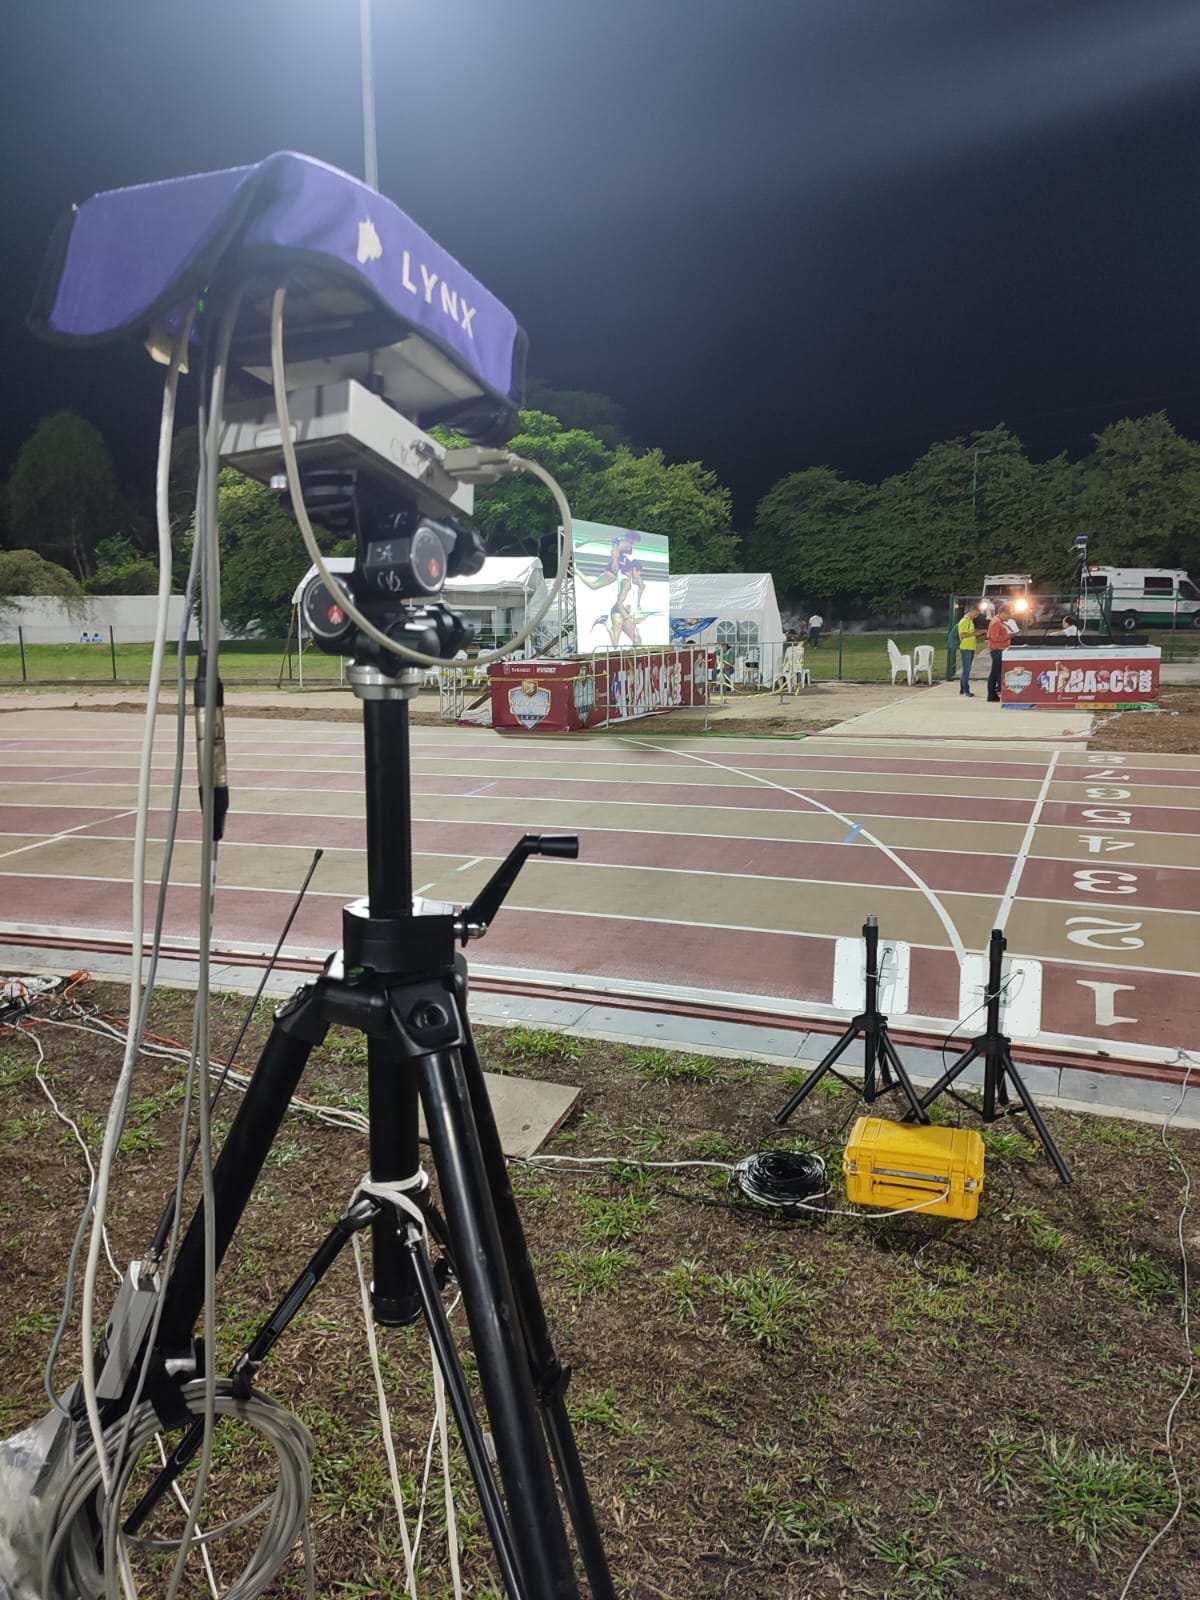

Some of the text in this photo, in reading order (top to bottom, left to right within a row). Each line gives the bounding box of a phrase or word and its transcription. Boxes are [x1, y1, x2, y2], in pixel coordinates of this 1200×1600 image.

[402, 250, 476, 339] LYNX
[1088, 754, 1126, 764] 8
[1084, 770, 1130, 781] 7
[1081, 809, 1133, 824] 5
[1077, 834, 1135, 853] 4
[1072, 869, 1138, 894] 3
[1064, 916, 1145, 950] 2
[1076, 979, 1139, 1026] 1
